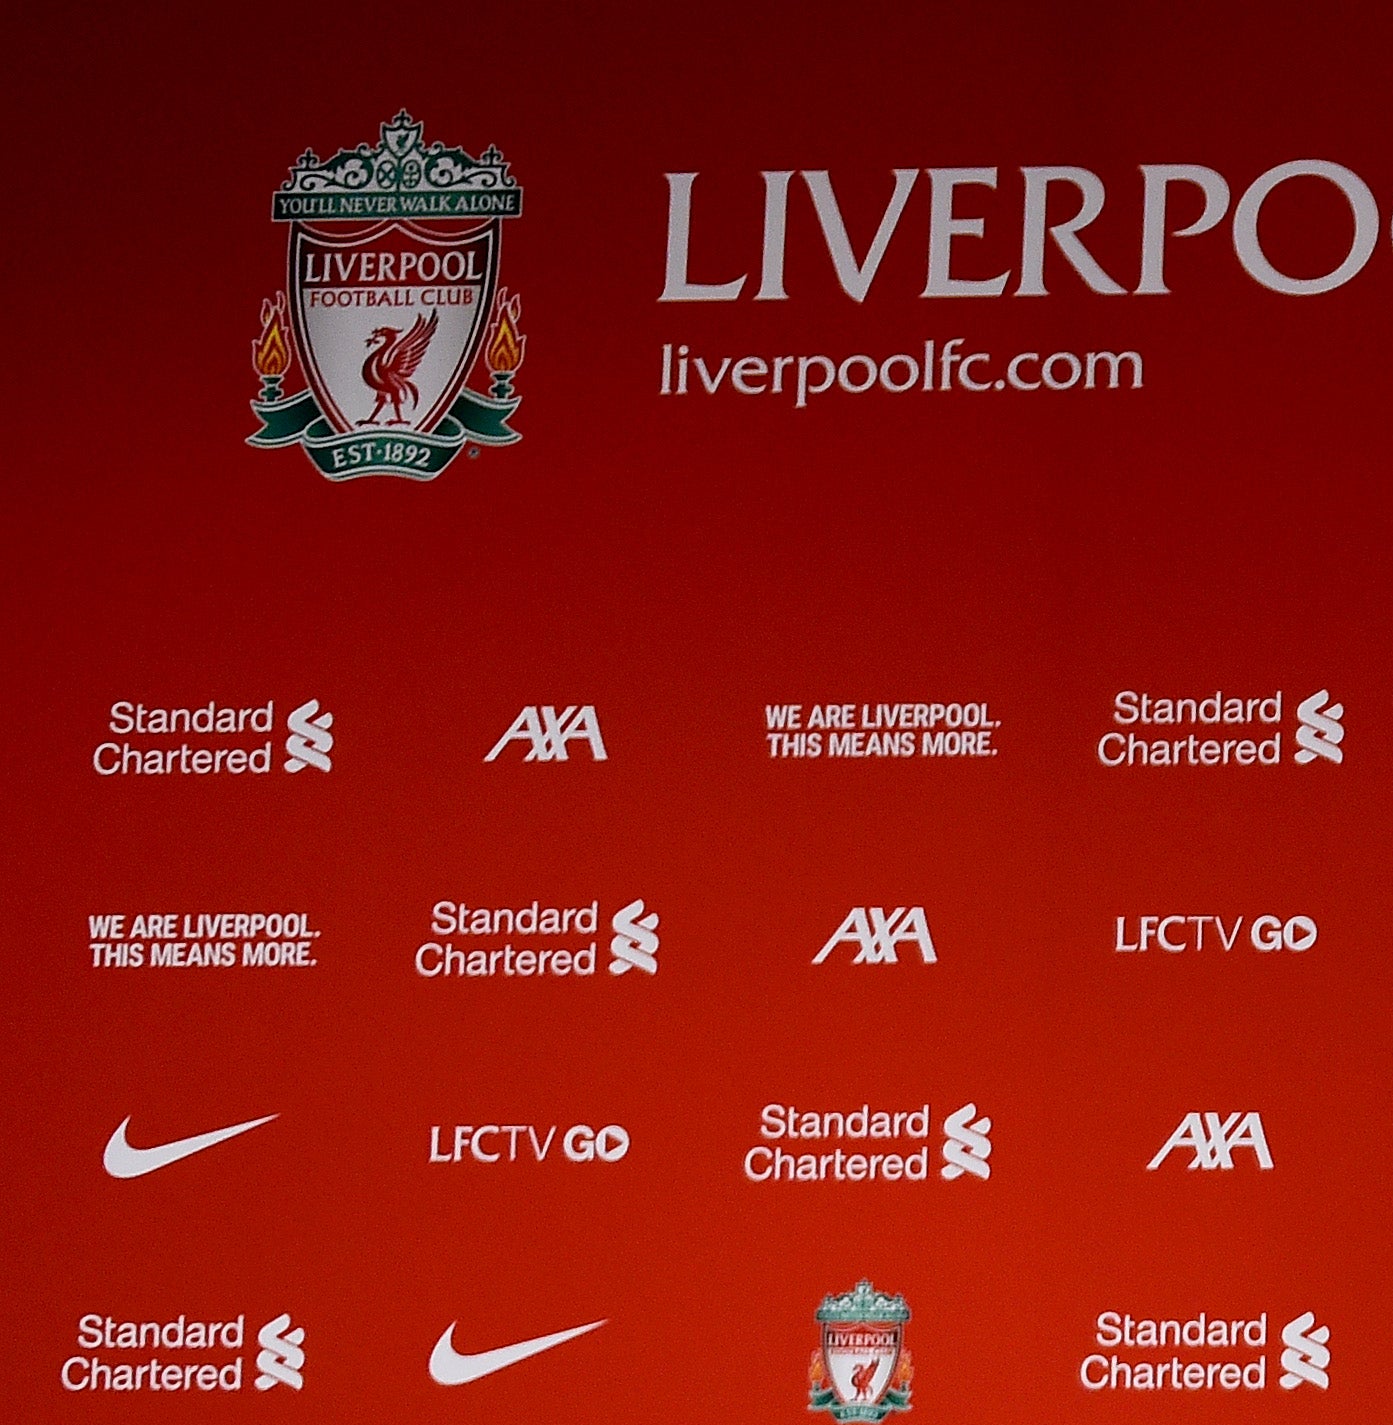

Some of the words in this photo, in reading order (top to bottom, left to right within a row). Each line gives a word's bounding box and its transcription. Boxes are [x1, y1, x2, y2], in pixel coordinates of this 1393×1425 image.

[340, 196, 398, 213] NEVER
[400, 195, 451, 212] WALK
[454, 194, 515, 212] ALONE
[304, 251, 482, 283] LIVERPOOL
[310, 289, 418, 307] FOOTBALL
[421, 287, 474, 306] CLUB
[661, 339, 1143, 408] liverpoolfc.com
[109, 700, 273, 734] Standard
[765, 705, 802, 730] WE
[807, 704, 856, 729] ARE
[861, 703, 1001, 729] LIVERPOOL.
[1114, 691, 1281, 724] Standard
[484, 705, 608, 762] AXA
[766, 733, 822, 758] THIS
[828, 732, 915, 757] MEANS
[922, 731, 997, 756] MORE.
[1098, 732, 1280, 766] Chartered
[93, 741, 271, 775] Chartered
[89, 915, 126, 939] WE
[129, 914, 179, 939] ARE
[183, 913, 321, 939] LIVERPOOL.
[431, 900, 598, 935] Standard
[811, 907, 937, 965] AXA
[89, 943, 144, 967] THIS
[150, 942, 236, 967] MEANS
[242, 941, 317, 966] MORE.
[415, 942, 596, 977] Chartered
[760, 1104, 929, 1139] Standard
[1146, 1112, 1274, 1171] AXA
[744, 1146, 928, 1182] Chartered
[78, 1314, 244, 1348] Standard
[828, 1333, 897, 1347] LIVERPOOL
[1096, 1311, 1266, 1347] Standard
[61, 1356, 242, 1391] Chartered
[1080, 1355, 1265, 1391] Chartered
